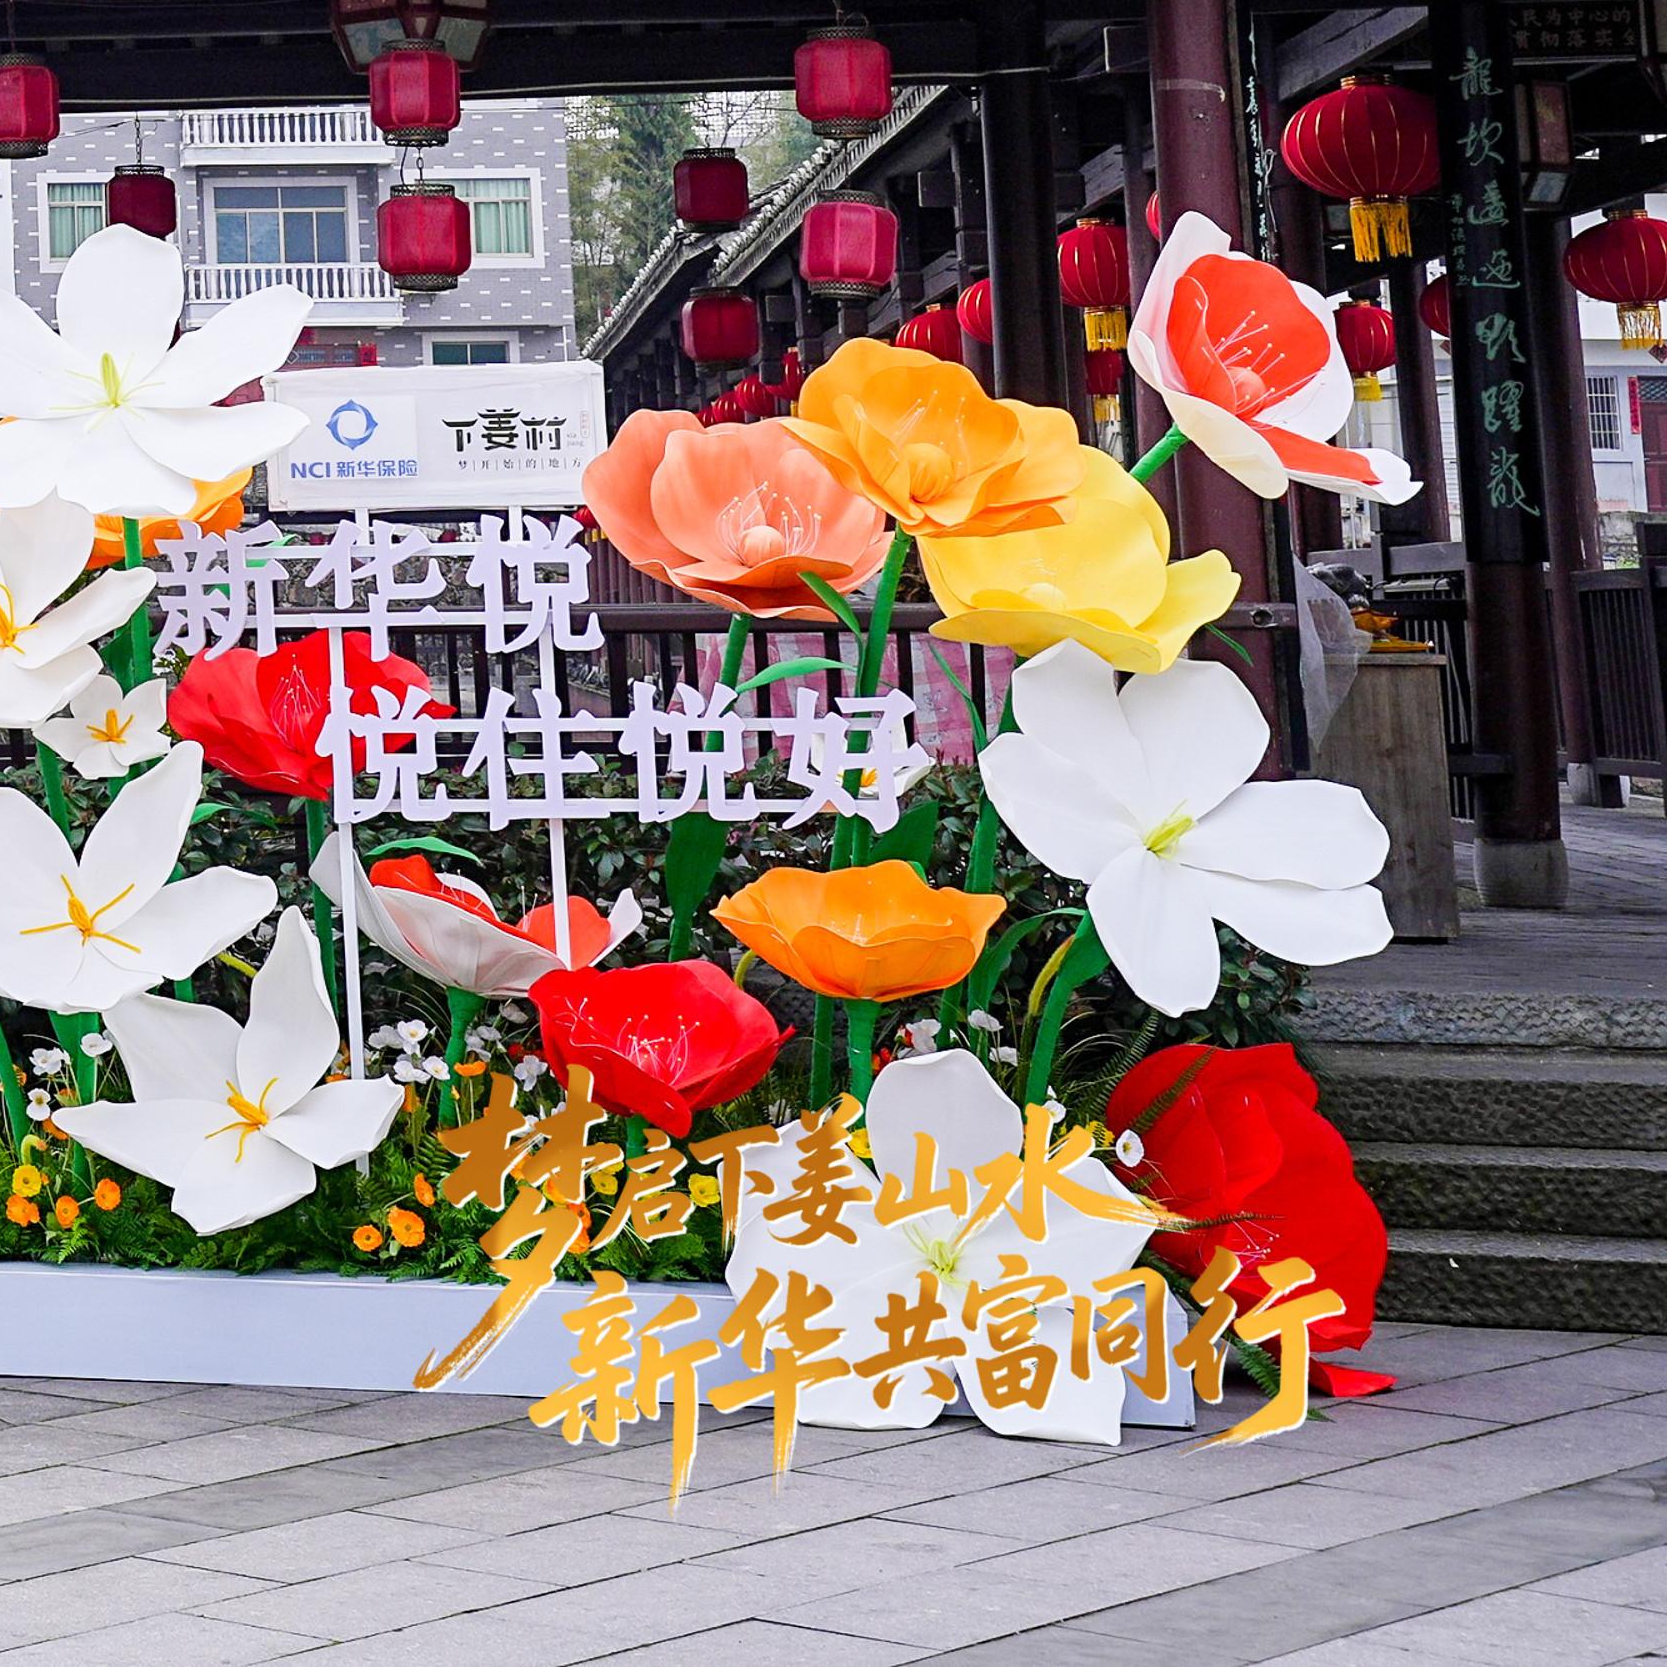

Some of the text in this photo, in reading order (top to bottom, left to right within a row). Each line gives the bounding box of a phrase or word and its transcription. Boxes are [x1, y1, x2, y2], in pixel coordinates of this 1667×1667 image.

[290, 459, 418, 479] NCI 新华保险
[442, 407, 567, 452] 下姜村
[153, 513, 605, 662] 新华悦
[314, 682, 931, 833] 悦住悦好
